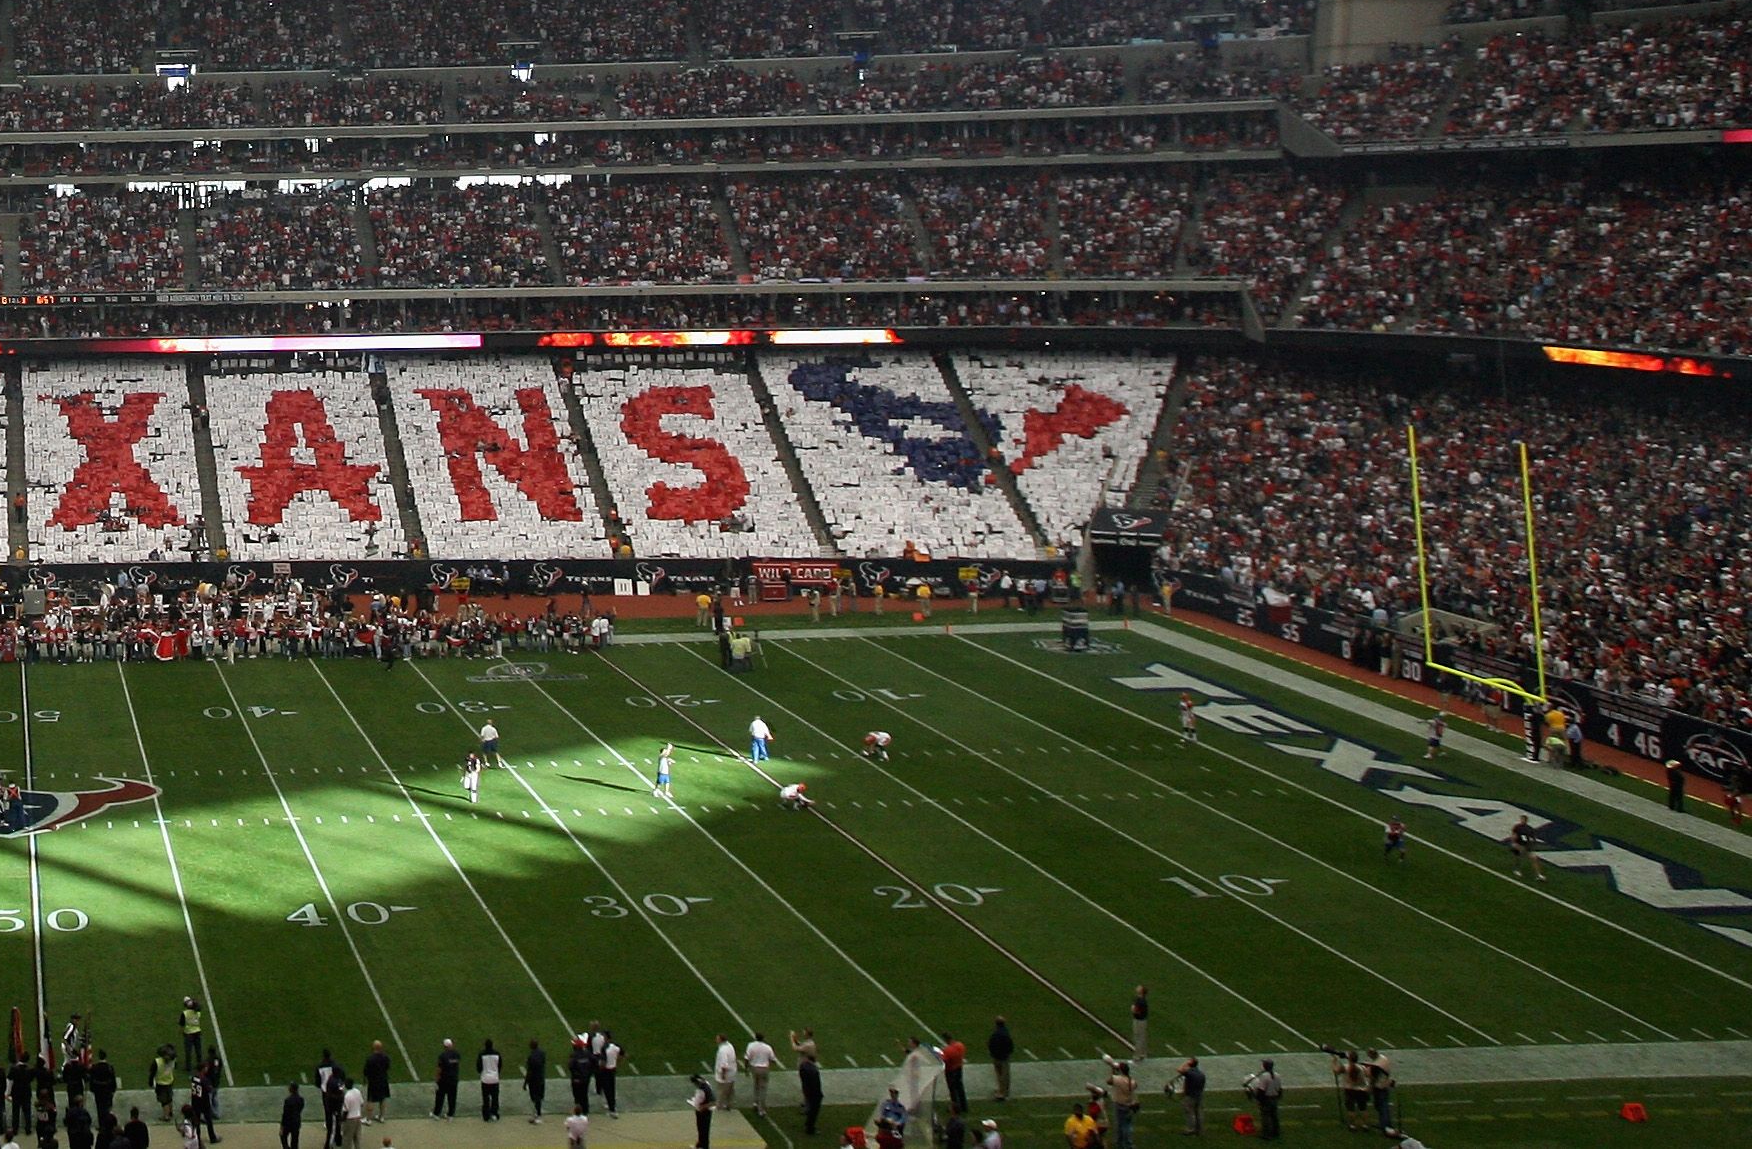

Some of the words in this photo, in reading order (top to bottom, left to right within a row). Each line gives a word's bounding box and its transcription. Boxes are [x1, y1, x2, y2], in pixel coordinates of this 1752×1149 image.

[797, 567, 832, 579] CARD
[1633, 731, 1662, 759] 46
[1110, 663, 1752, 947] TEXAN
[872, 883, 984, 909] 20
[1159, 874, 1275, 899] 10
[286, 901, 391, 927] 40
[581, 893, 689, 919] 30
